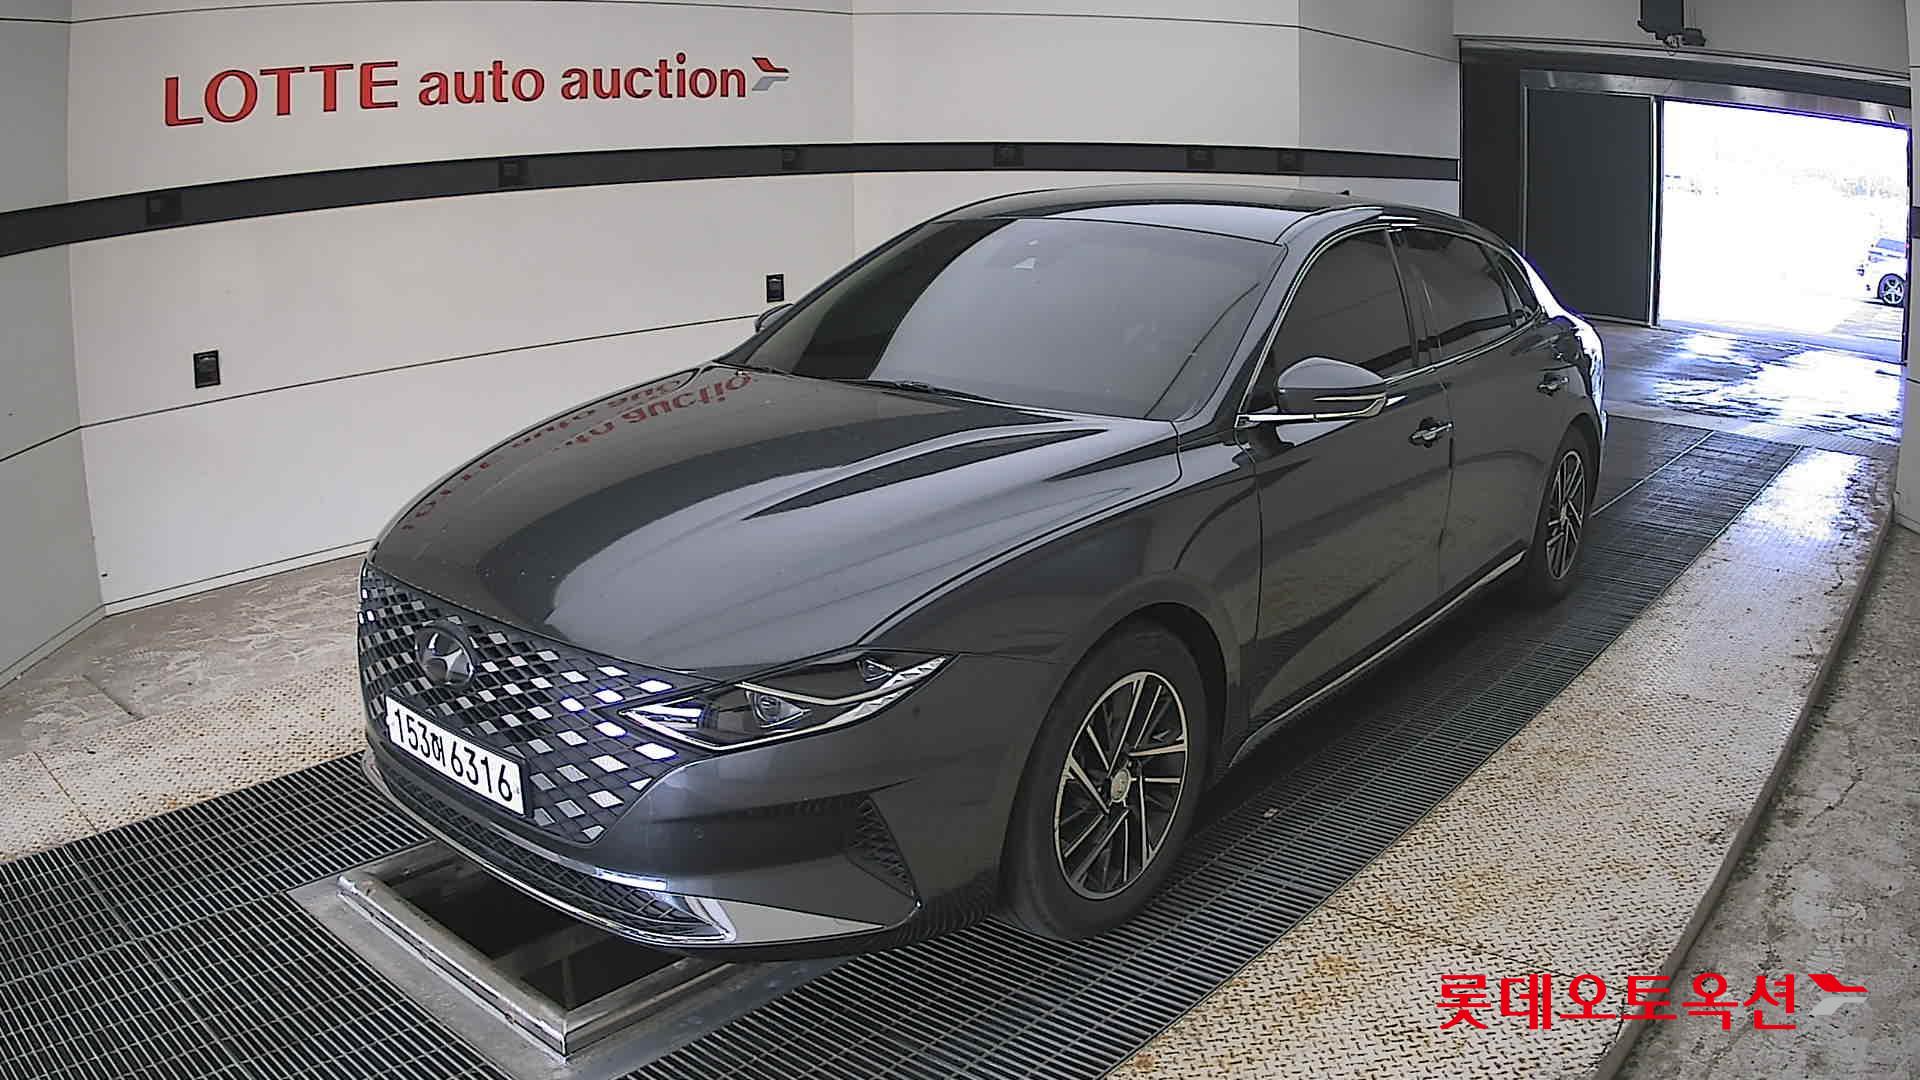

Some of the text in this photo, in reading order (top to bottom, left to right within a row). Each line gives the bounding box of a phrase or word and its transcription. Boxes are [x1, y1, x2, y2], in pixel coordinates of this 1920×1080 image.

[164, 52, 747, 127] LOTTE auto auction
[450, 740, 513, 802] 6316
